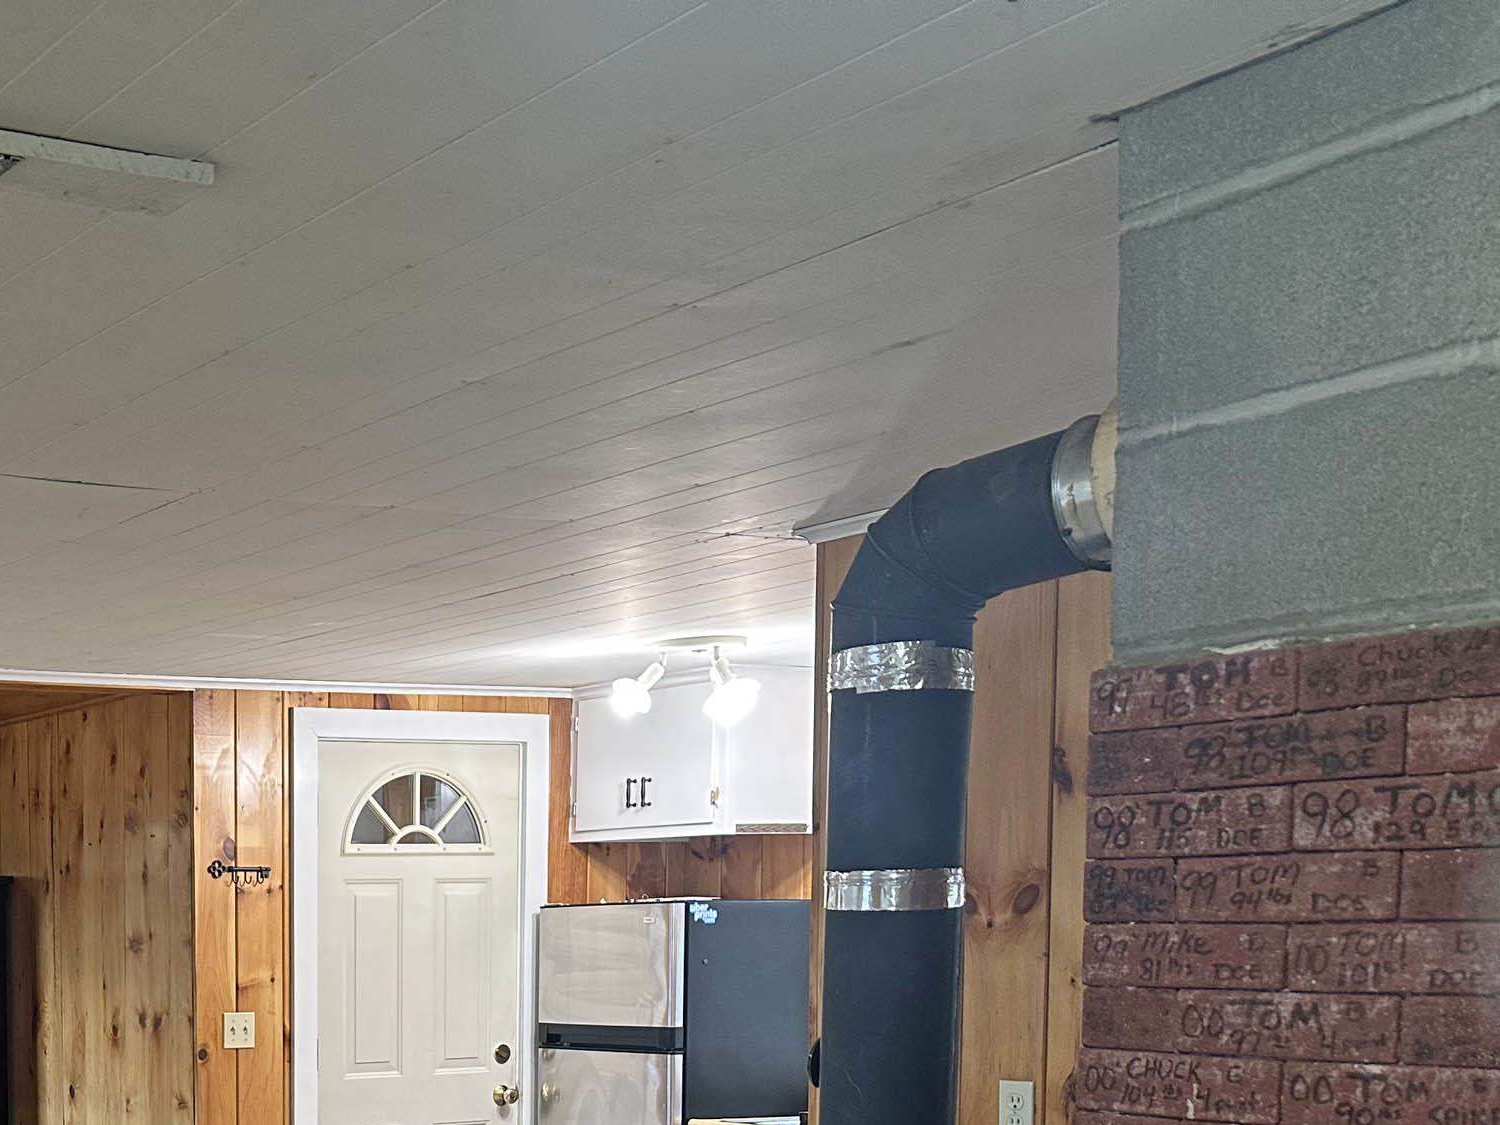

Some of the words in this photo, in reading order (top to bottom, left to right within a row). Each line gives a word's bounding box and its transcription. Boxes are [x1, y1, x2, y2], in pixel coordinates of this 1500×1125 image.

[1155, 656, 1253, 692] TOM
[1146, 795, 1225, 827] TOM
[1246, 792, 1267, 818] B
[1301, 788, 1359, 840] 98
[1373, 779, 1477, 819] TOM
[1224, 859, 1301, 890] TOM
[1181, 1004, 1225, 1038] 00
[1125, 1056, 1203, 1085] CHUCK
[1195, 1087, 1212, 1112] 4
[1289, 1072, 1334, 1105] 00
[1345, 1071, 1430, 1106] TOM
